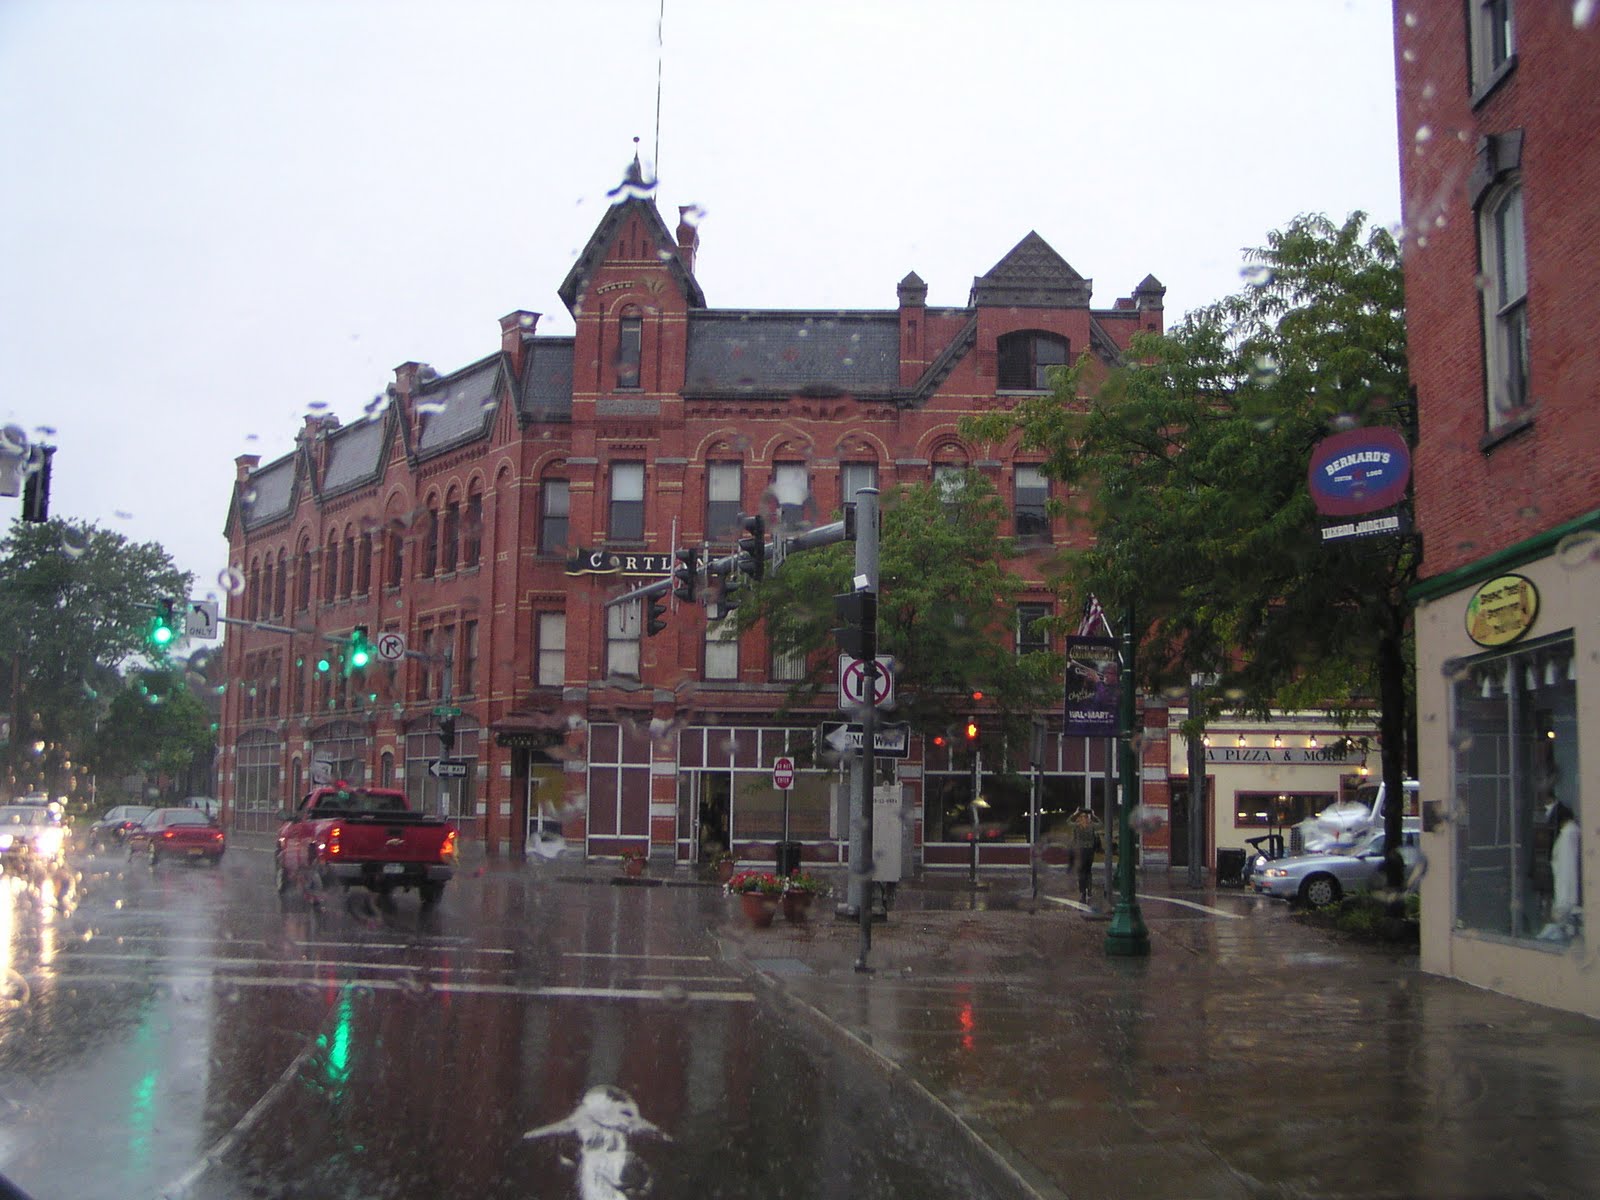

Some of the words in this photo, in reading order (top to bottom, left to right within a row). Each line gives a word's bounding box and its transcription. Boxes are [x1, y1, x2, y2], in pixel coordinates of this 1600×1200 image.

[1325, 451, 1391, 476] BERNARD'S
[190, 628, 213, 636] ONLY
[1225, 750, 1271, 760] PIZZA
[1283, 750, 1292, 760] &
